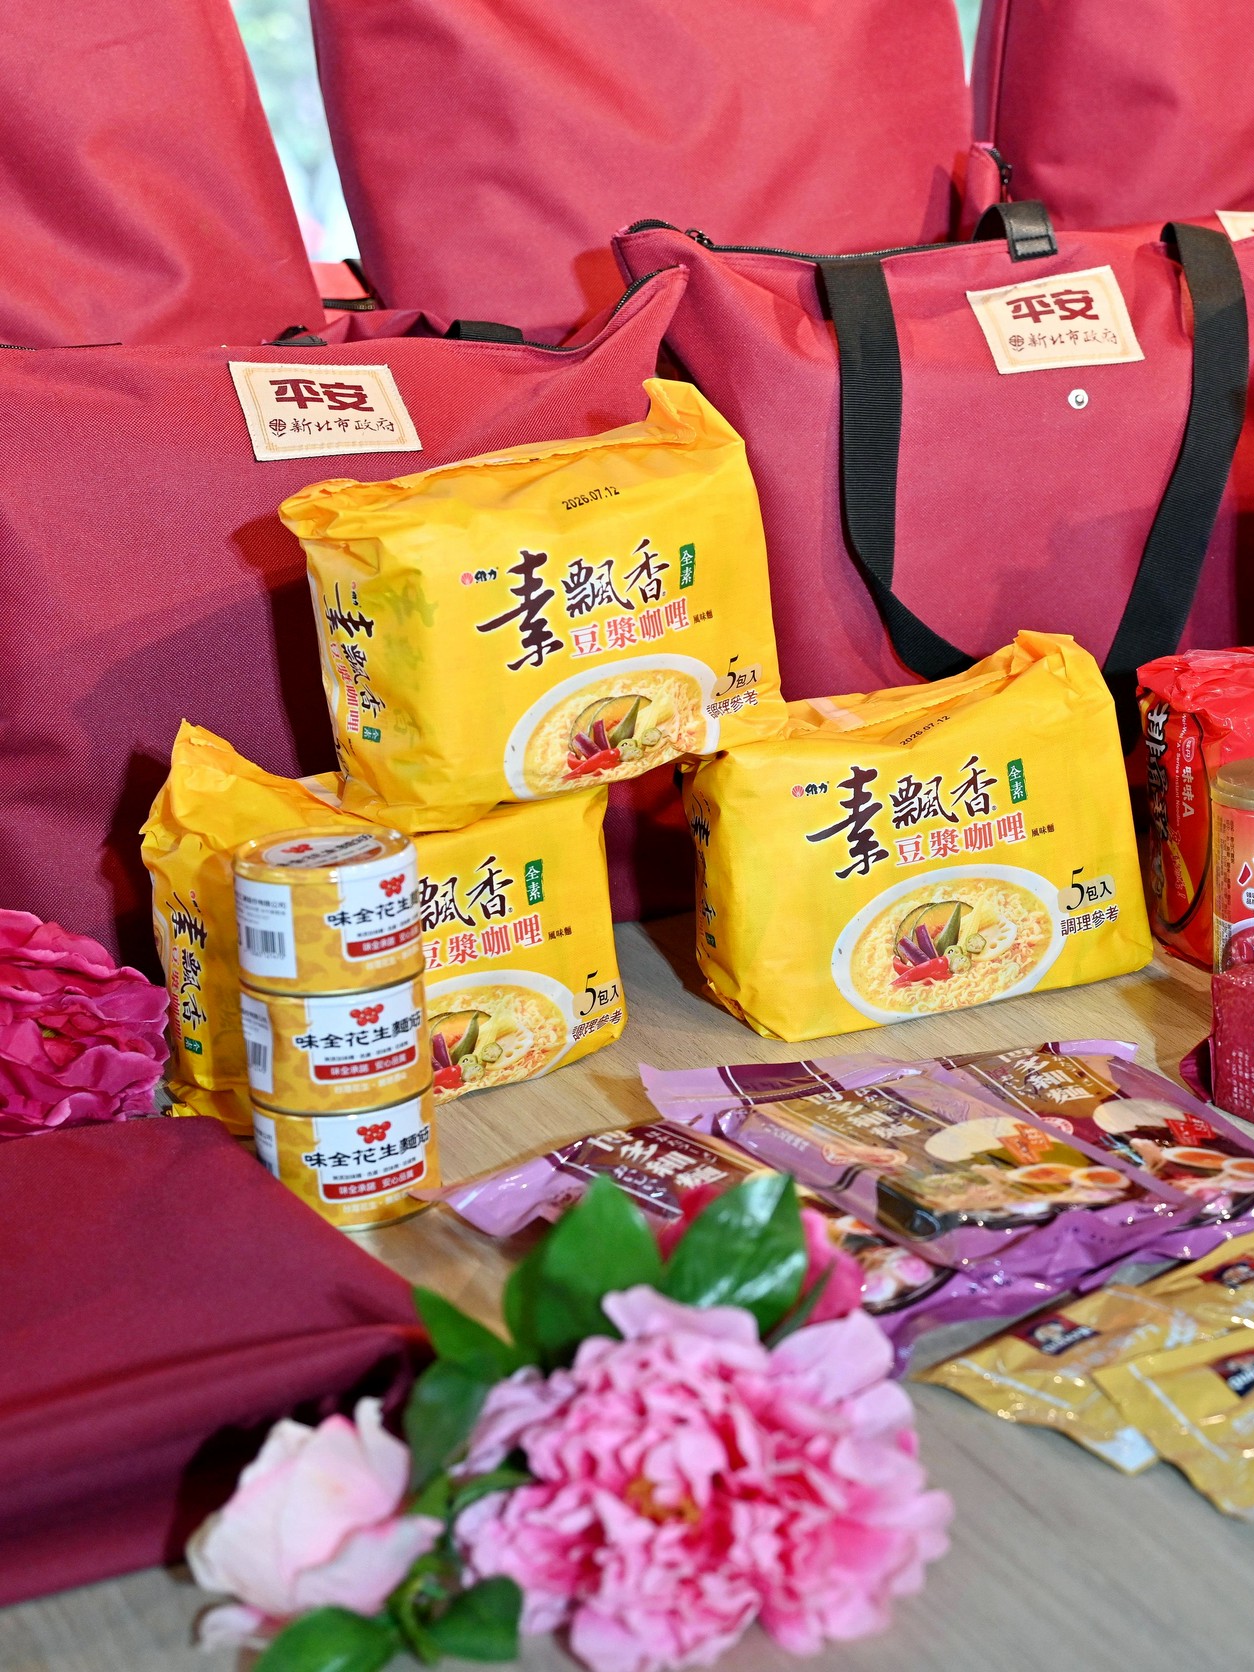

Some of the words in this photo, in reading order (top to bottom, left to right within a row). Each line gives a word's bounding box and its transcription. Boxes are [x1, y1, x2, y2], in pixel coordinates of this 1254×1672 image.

[1006, 289, 1100, 324] 平安
[1027, 328, 1118, 350] 新北市政府
[269, 378, 375, 412] 平安
[289, 417, 395, 435] 新北市政府
[561, 486, 620, 511] 2026.07.12
[681, 548, 694, 587] 全素
[476, 538, 671, 671] 素飄香
[570, 598, 691, 659] 豆漿咖哩
[716, 655, 758, 697] 5包入
[706, 690, 758, 720] 調理參考
[899, 714, 950, 747] 2026.07.12
[1008, 763, 1025, 801] 全素
[1182, 766, 1195, 818] 味味A
[806, 755, 998, 880] 素飄香
[1031, 823, 1055, 838] 風味麵
[895, 812, 1026, 867] 豆漿咖哩
[525, 864, 541, 902] 全素
[1066, 866, 1113, 911] 5包入
[1060, 905, 1119, 938] 調理參考
[422, 915, 543, 970] 豆漿咖哩
[580, 970, 620, 1016] 5包入
[295, 1011, 421, 1050] 味全花生麵筋
[571, 1006, 623, 1042] 調理參考
[304, 1126, 430, 1168] 味全花生麵筋
